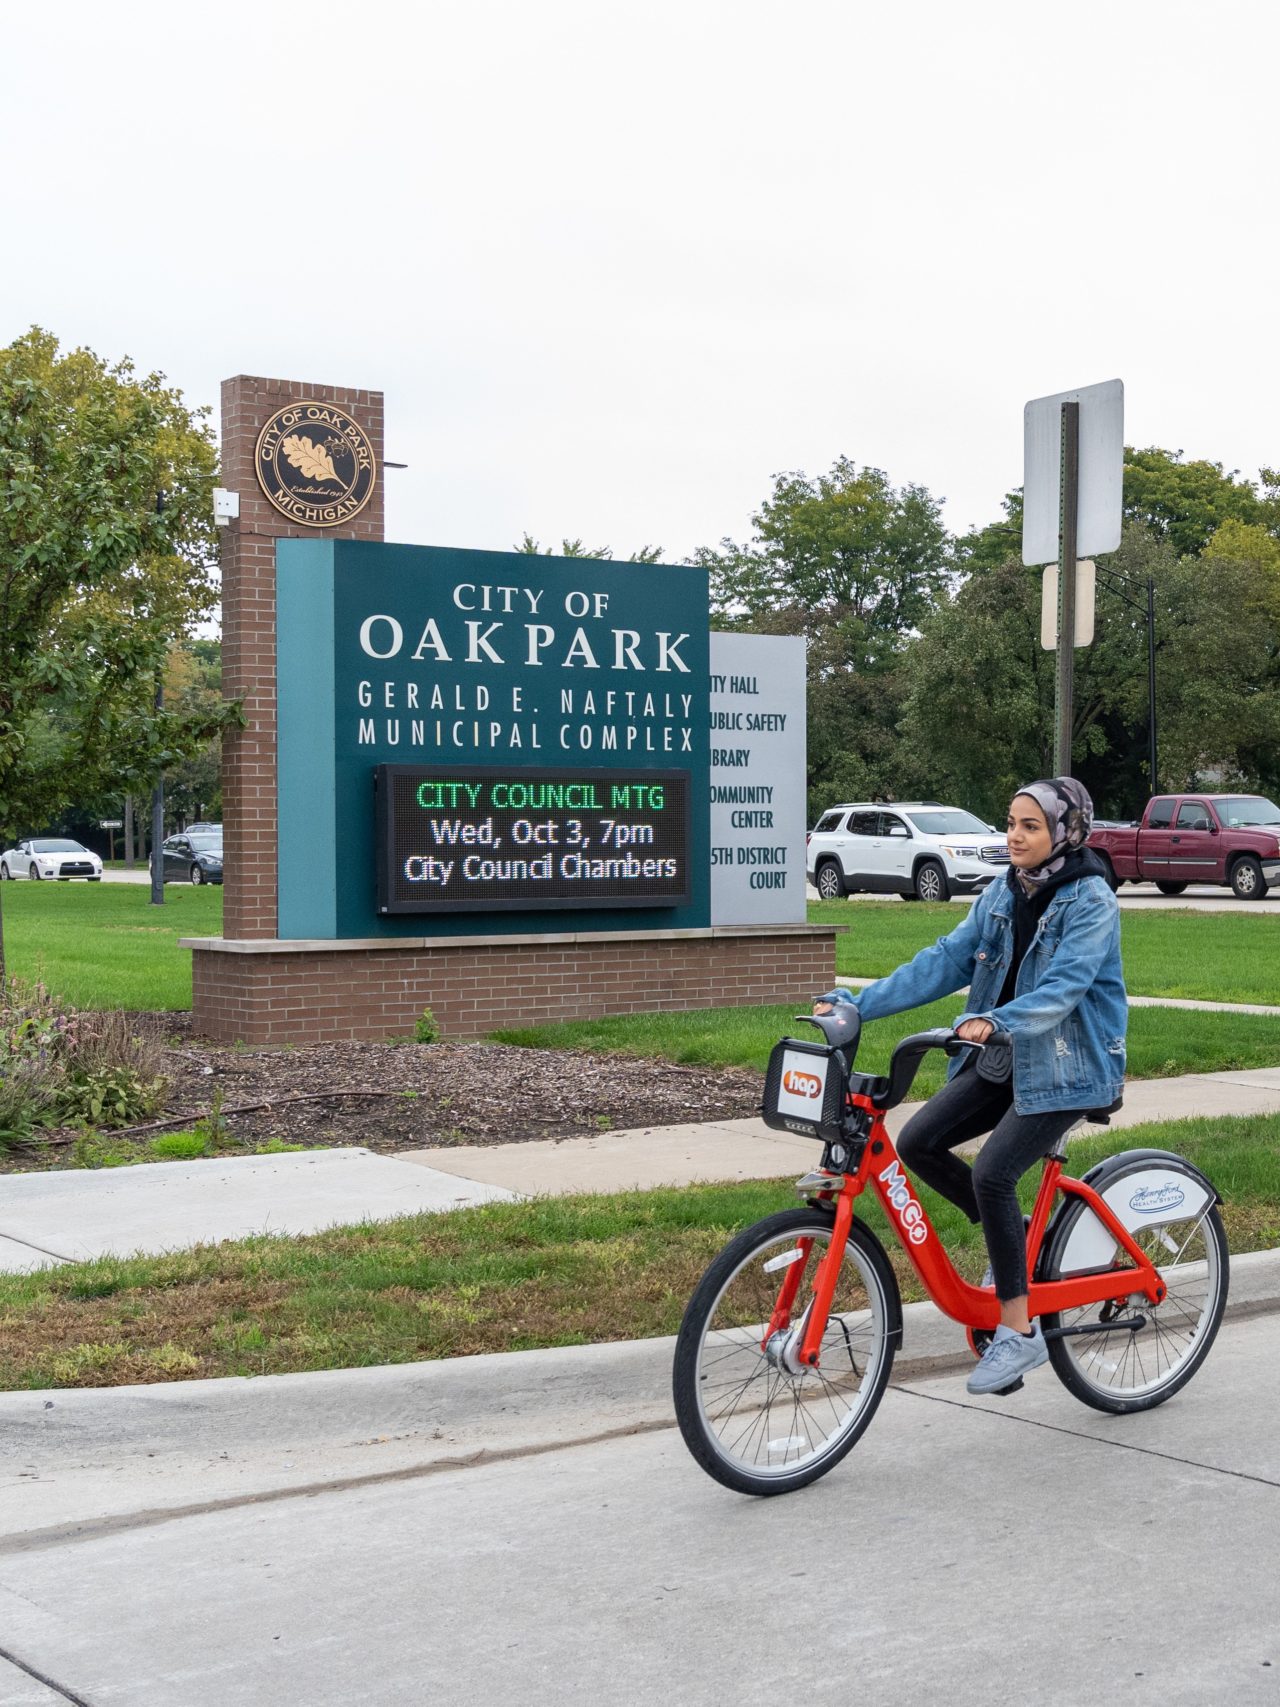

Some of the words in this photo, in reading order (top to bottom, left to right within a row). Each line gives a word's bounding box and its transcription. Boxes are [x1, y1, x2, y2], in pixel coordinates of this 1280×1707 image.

[260, 424, 282, 461] CITY
[282, 409, 303, 426] OF
[306, 407, 345, 429] OAK
[344, 425, 372, 471] PARK
[273, 488, 360, 521] MICHIGAN
[453, 583, 544, 614] CITY
[564, 591, 610, 618] OF
[359, 614, 506, 665] OAK
[524, 624, 692, 673] PARK
[709, 675, 727, 693] ITY
[730, 675, 760, 694] HALL
[358, 680, 491, 712] GERALD
[513, 686, 539, 713] E.
[561, 688, 693, 718] NAFTALY
[709, 711, 744, 730] UBLIC
[746, 713, 787, 732] SAFETY
[358, 718, 542, 748] MUNICIPAL
[560, 723, 693, 752] COMPLEX
[709, 748, 751, 767] BRARY
[416, 783, 483, 808] CITY
[491, 784, 604, 809] COUNCIL
[610, 785, 665, 809] MTG
[709, 786, 774, 804] OMMUNITY
[731, 810, 774, 829] CENTER
[430, 817, 502, 849] Wed,
[511, 820, 560, 844] Oct
[566, 820, 591, 848] 3,
[599, 820, 654, 848] 7pm
[404, 855, 455, 886] City
[463, 852, 554, 880] Council
[559, 852, 678, 879] Chambers
[710, 847, 734, 866] 5TH
[737, 847, 788, 865] DISTRICT
[749, 871, 788, 890] COURT
[788, 1070, 819, 1098] hap
[1135, 1186, 1162, 1202] Henry
[1158, 1194, 1183, 1204] SYSTEM
